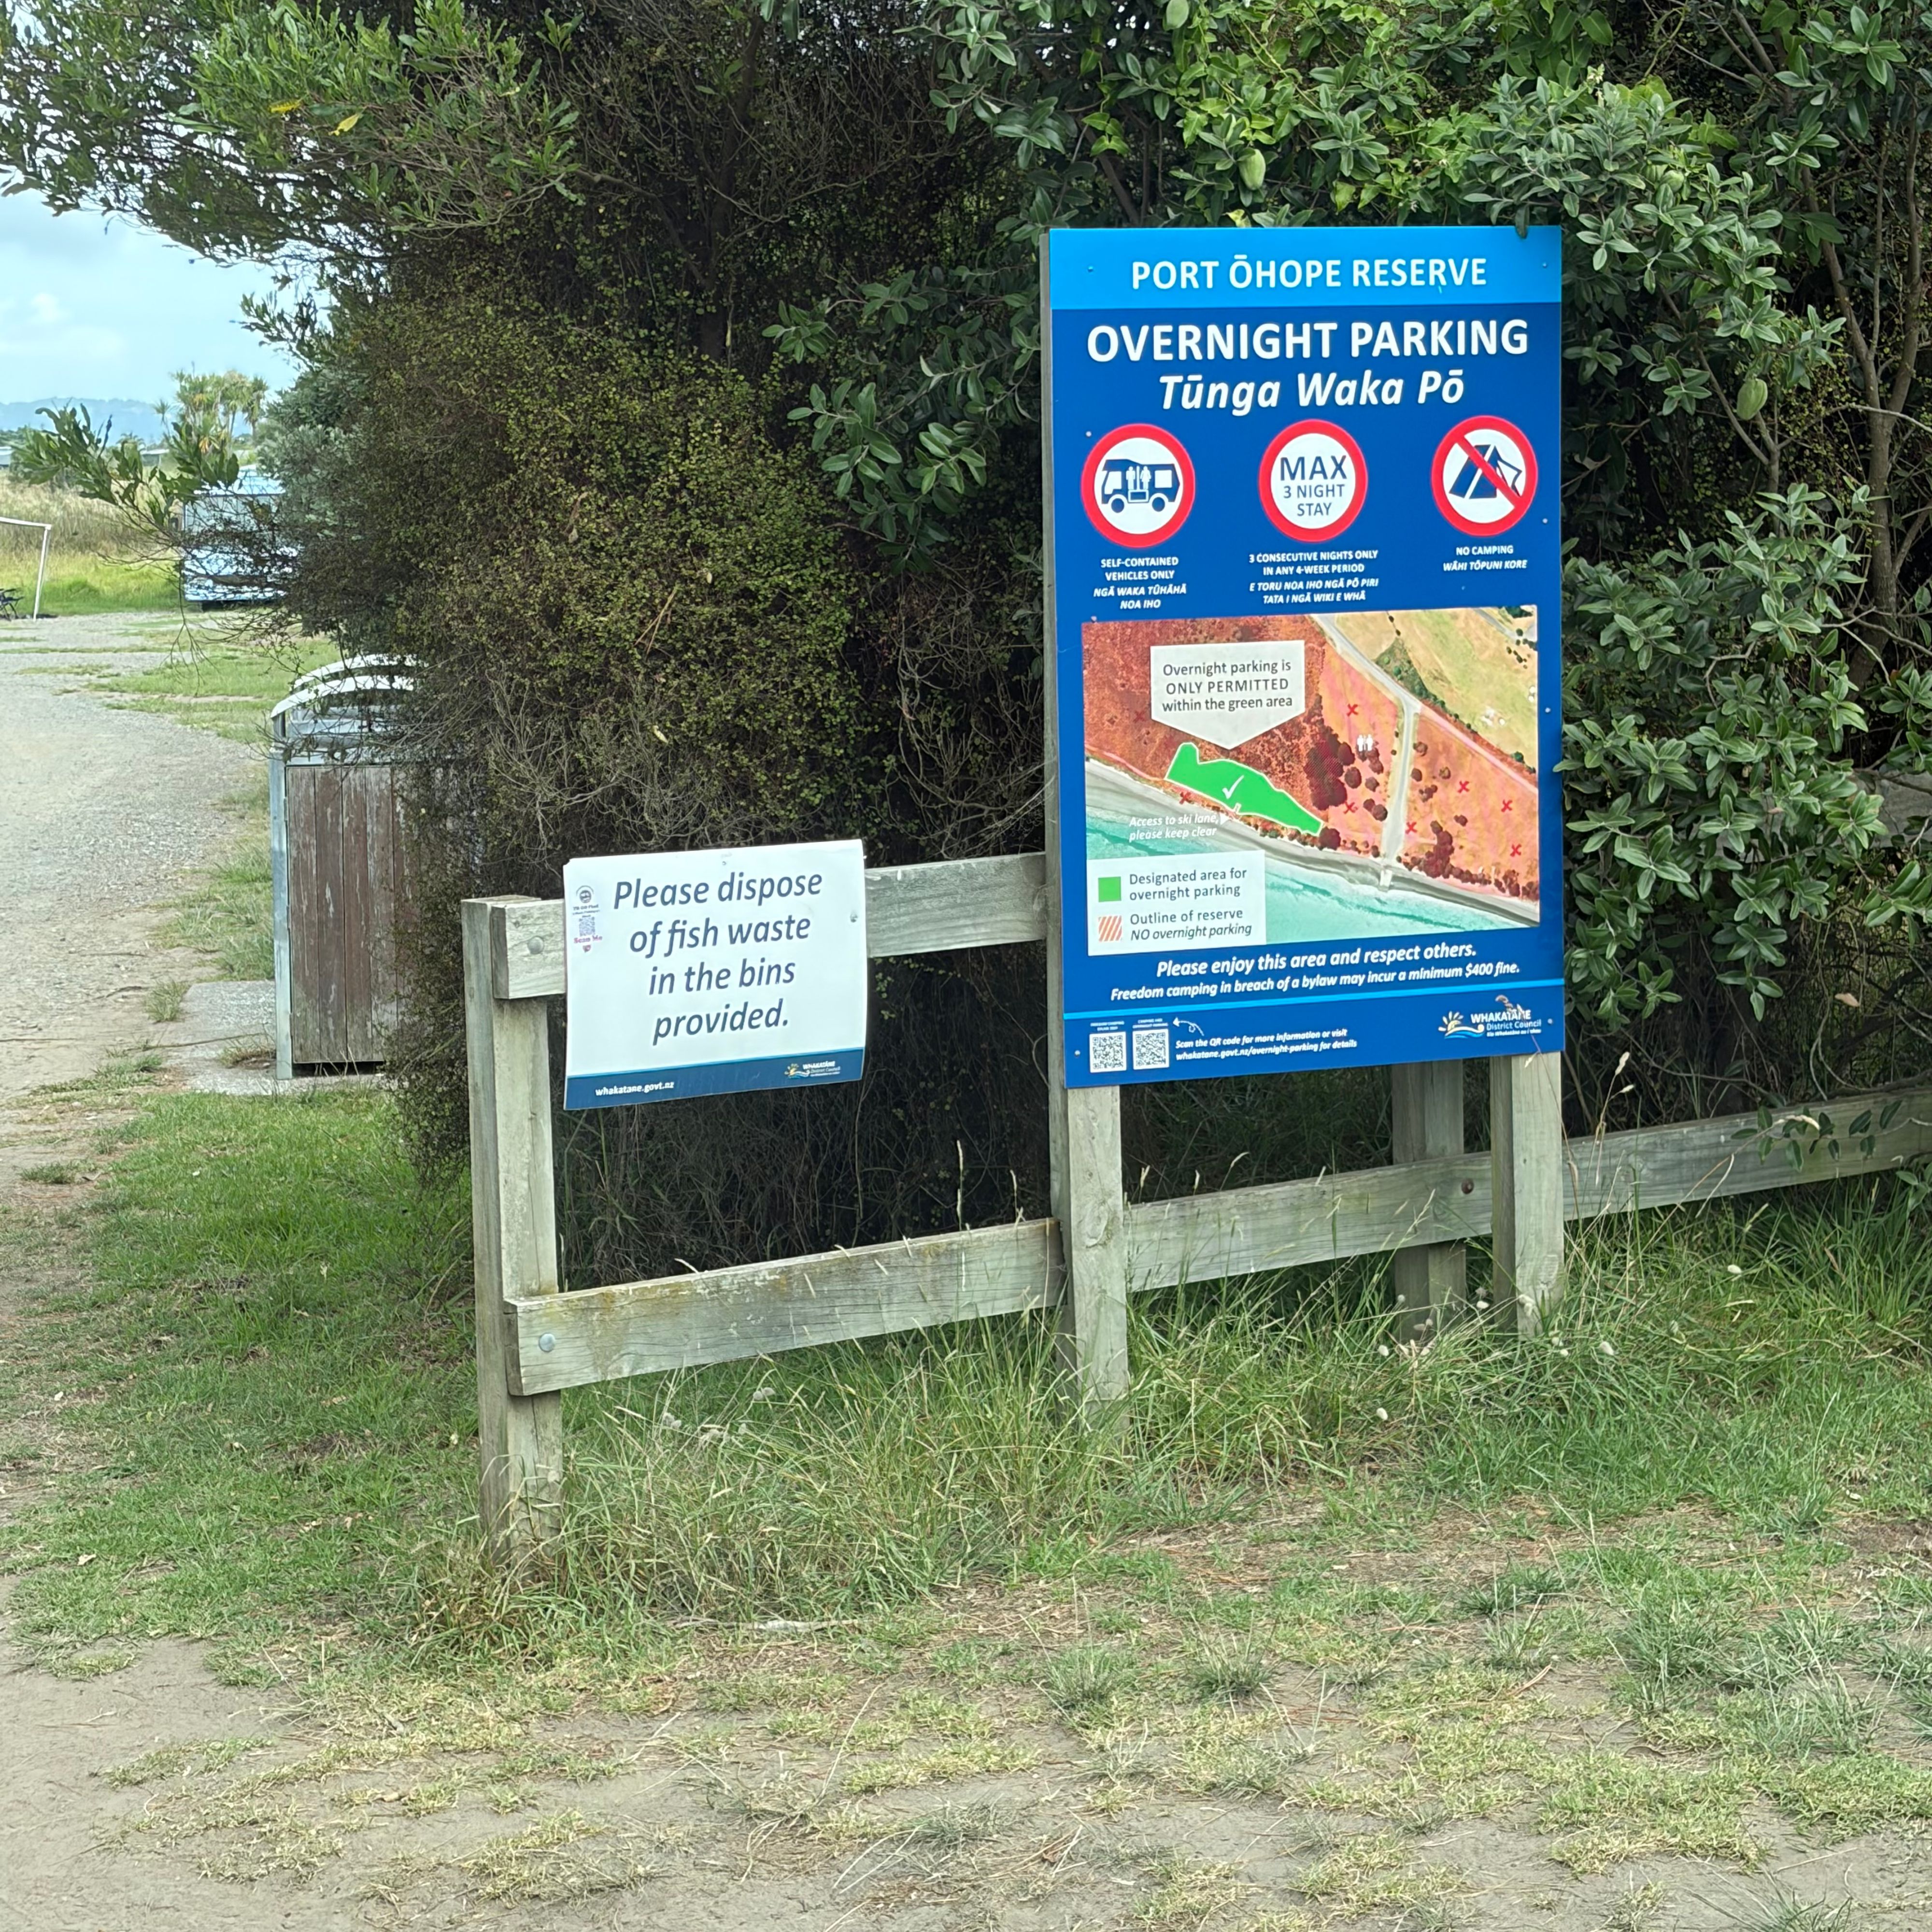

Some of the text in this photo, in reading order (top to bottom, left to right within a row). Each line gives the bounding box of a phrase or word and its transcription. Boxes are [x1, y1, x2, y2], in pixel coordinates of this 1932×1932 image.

[1132, 254, 1487, 289] PORT ŌHOPE RESERVE
[1087, 319, 1528, 362] OVERNIGHT PARKING
[1160, 369, 1464, 416] Tūnga Waka Pō
[1280, 455, 1347, 481] MAX
[1283, 484, 1345, 498] 3 NIGHT
[1297, 502, 1332, 516] STAY
[1249, 550, 1378, 563] 3 CONSECUTIVE NIGHTS ONLY
[1456, 545, 1513, 555] NO CAMPING
[1101, 557, 1179, 568] SELF-CONTAINED
[1264, 563, 1364, 575] IN ANY 4-WEEK PERIOD
[1443, 560, 1527, 571] WĀHI TŌPUNI KORE
[1105, 570, 1175, 581] VEHICLES ONLY
[1094, 586, 1114, 597] NGĀ
[1117, 586, 1145, 596] WAKA
[1250, 577, 1378, 591] E TORU NOA IHO NGĀ PŌ PIRI
[1120, 599, 1161, 609] NOA IHO
[1264, 595, 1284, 604] TATA
[1292, 592, 1311, 603] NGĀ
[1313, 593, 1334, 602] WIKI
[1336, 593, 1341, 601] E
[1344, 590, 1365, 600] WHĀ
[1163, 659, 1291, 676] Overnight parking is
[1166, 678, 1288, 695] ONLY PERMITTED
[1162, 697, 1292, 712] within the green area
[1129, 813, 1219, 827] Access to ski lane,
[1129, 826, 1217, 842] please keep clear
[1130, 867, 1247, 885] Designated area for
[613, 871, 823, 909] Please dispose
[1130, 884, 1240, 900] overnight parking
[1130, 910, 1243, 925] Outline of reserve
[630, 915, 810, 958] of fish waste
[1131, 923, 1252, 941] NO overnight parking
[1157, 942, 1476, 977] Please enjoy this area and respect others.
[649, 957, 795, 995] in the bins
[1111, 962, 1520, 1000] Freedom camping in breach of a bylaw may incur a minimum $400 fine.
[653, 998, 788, 1046] provided.
[1487, 1019, 1541, 1031] District Council
[1176, 1040, 1193, 1049] Scan
[1209, 1038, 1221, 1047] QR
[1222, 1036, 1241, 1045] code
[1241, 1035, 1253, 1046] for
[1276, 1031, 1320, 1043] information
[1331, 1028, 1348, 1037] visit
[1319, 1041, 1331, 1051] for
[1332, 1039, 1357, 1049] details
[595, 1081, 675, 1096] whakatane.govt.nz
